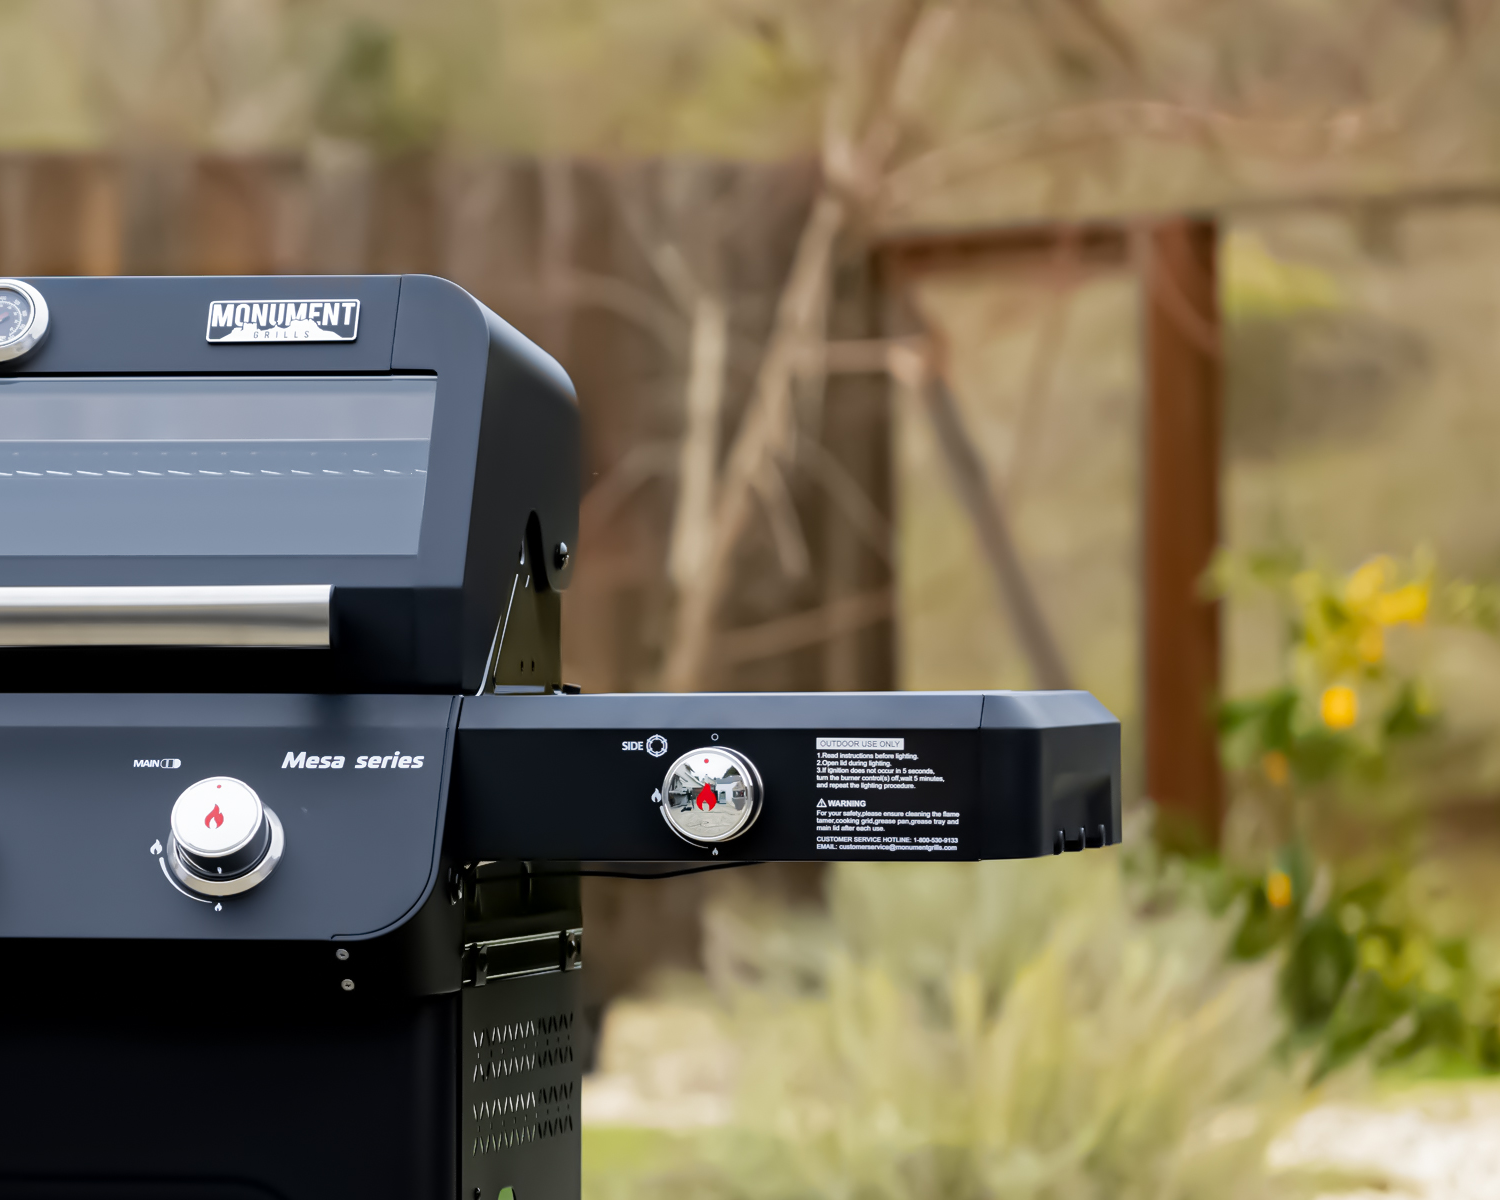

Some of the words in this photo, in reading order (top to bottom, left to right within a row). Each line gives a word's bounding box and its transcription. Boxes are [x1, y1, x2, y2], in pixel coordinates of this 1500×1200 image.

[211, 302, 356, 327] MONUMENT
[253, 331, 310, 339] GRILLS
[621, 741, 644, 751] SIDE
[133, 759, 160, 768] MAIN
[281, 751, 346, 769] Mesa
[354, 751, 425, 769] series
[827, 799, 866, 807] WARNING
[905, 810, 930, 818] cleaning
